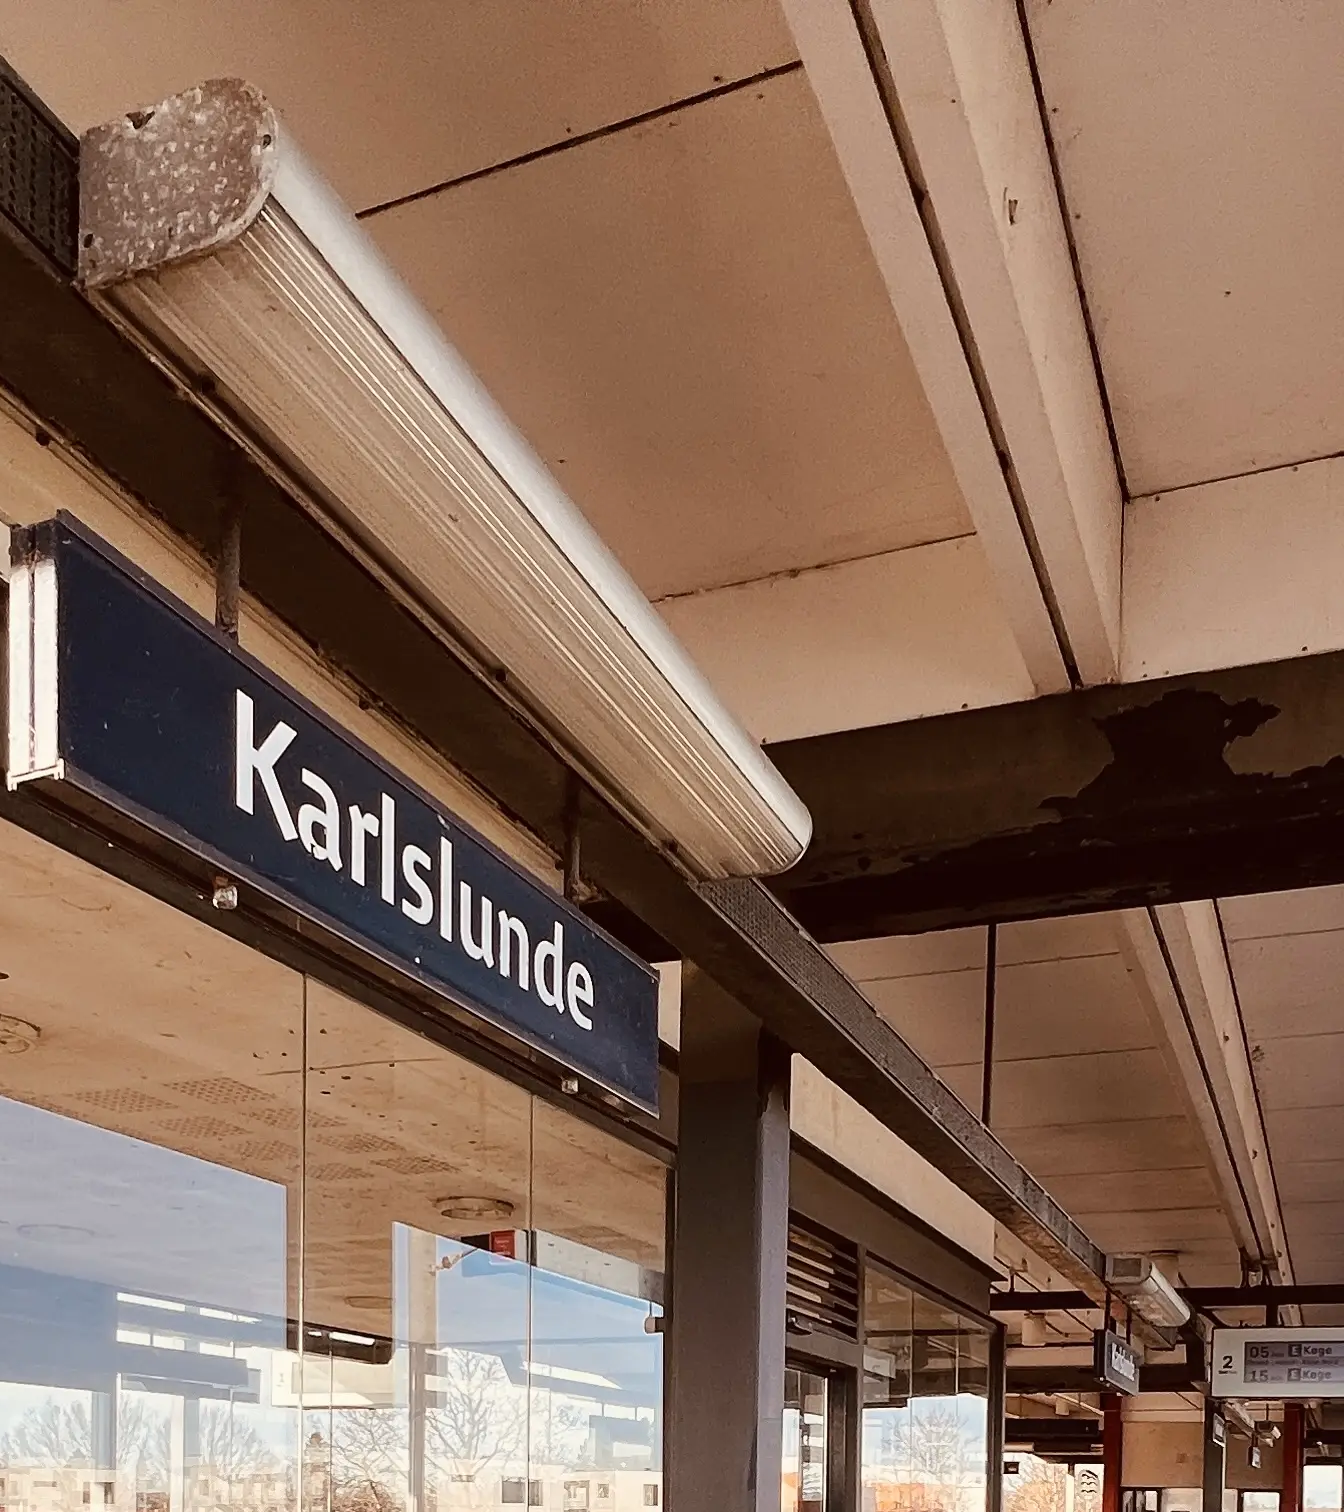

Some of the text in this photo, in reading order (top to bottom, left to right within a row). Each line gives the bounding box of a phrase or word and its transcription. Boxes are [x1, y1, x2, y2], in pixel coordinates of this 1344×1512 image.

[235, 689, 596, 1032] Karlslunde
[1249, 1345, 1269, 1359] 05
[1222, 1355, 1233, 1370] 2
